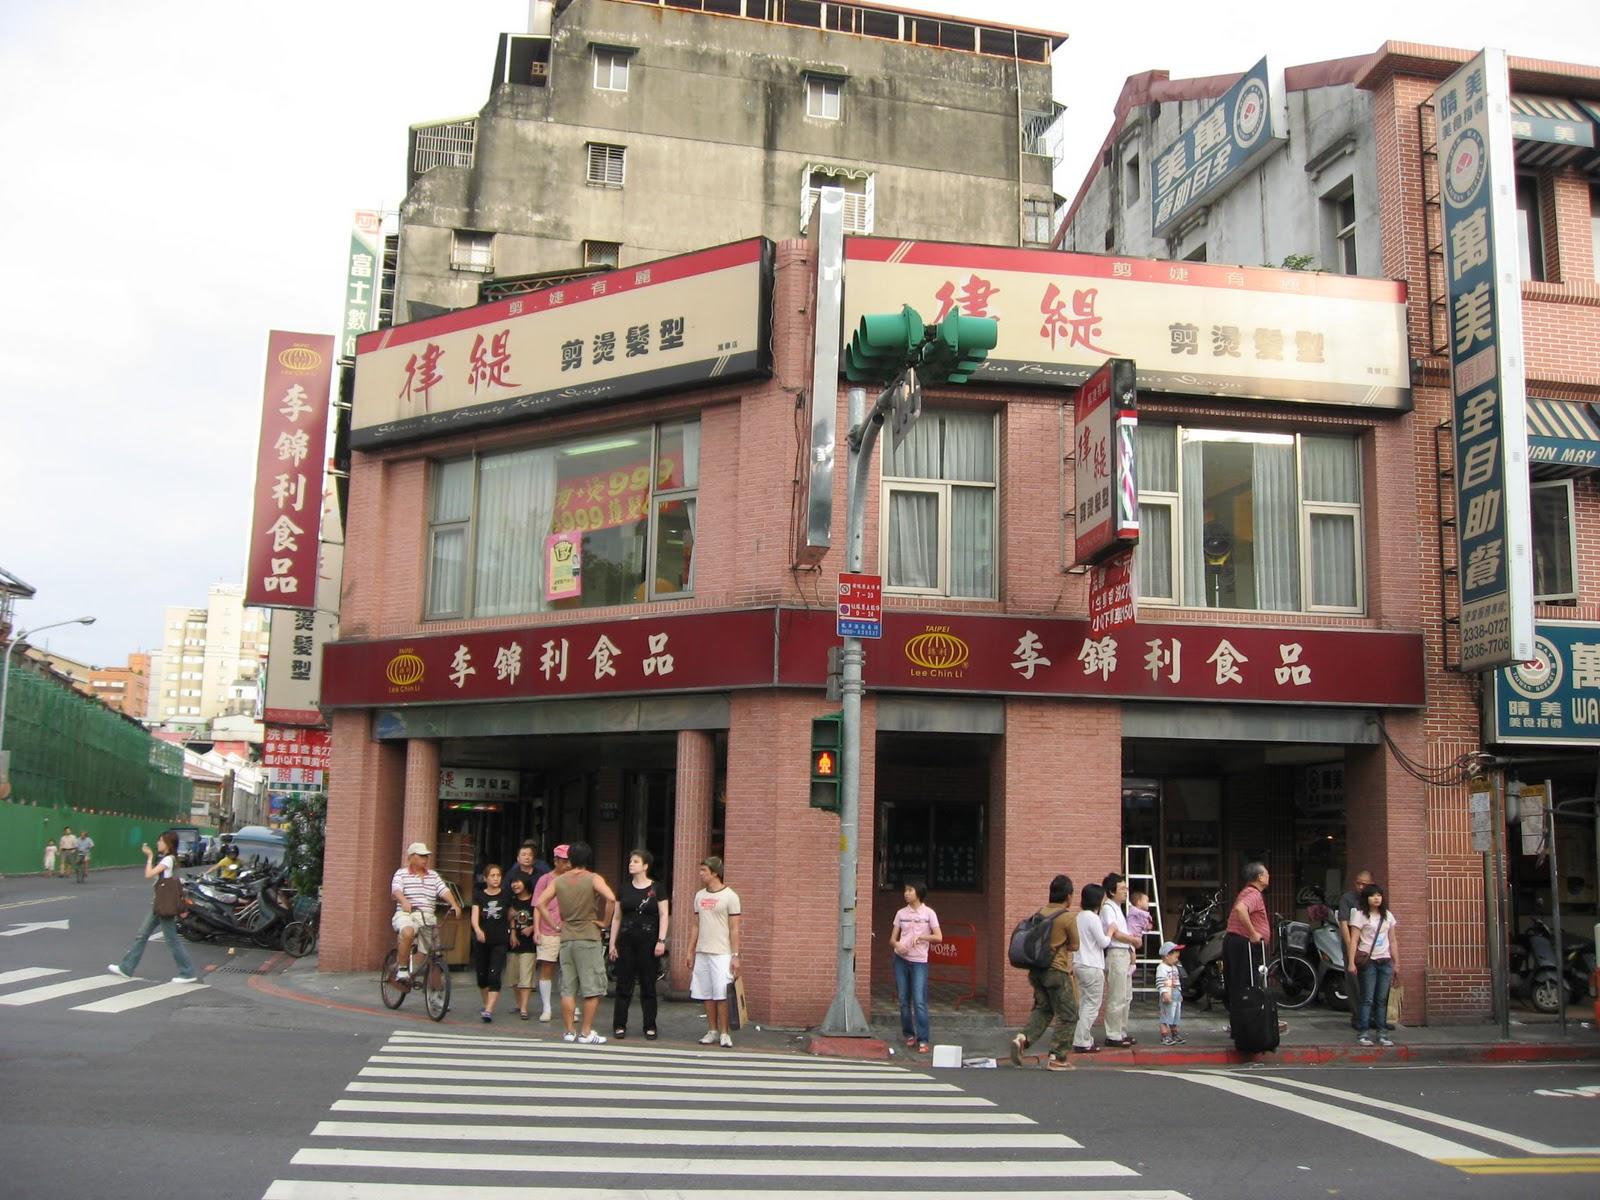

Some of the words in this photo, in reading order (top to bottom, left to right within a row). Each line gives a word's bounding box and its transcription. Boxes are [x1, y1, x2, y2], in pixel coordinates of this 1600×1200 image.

[559, 316, 685, 373] 剪燙髮型
[1560, 447, 1597, 464] MAY
[262, 383, 314, 595] 李錦利食品
[1459, 388, 1502, 591] 全自助餐
[925, 625, 950, 633] TAIPEI
[1463, 617, 1509, 643] 2338-0727
[448, 632, 675, 689] 李錦利食品
[1009, 629, 1312, 686] 李錦利食品
[1463, 637, 1510, 660] 2336-7706
[910, 668, 928, 677] Lee
[930, 668, 953, 678] Chin
[276, 768, 315, 783] 照相
